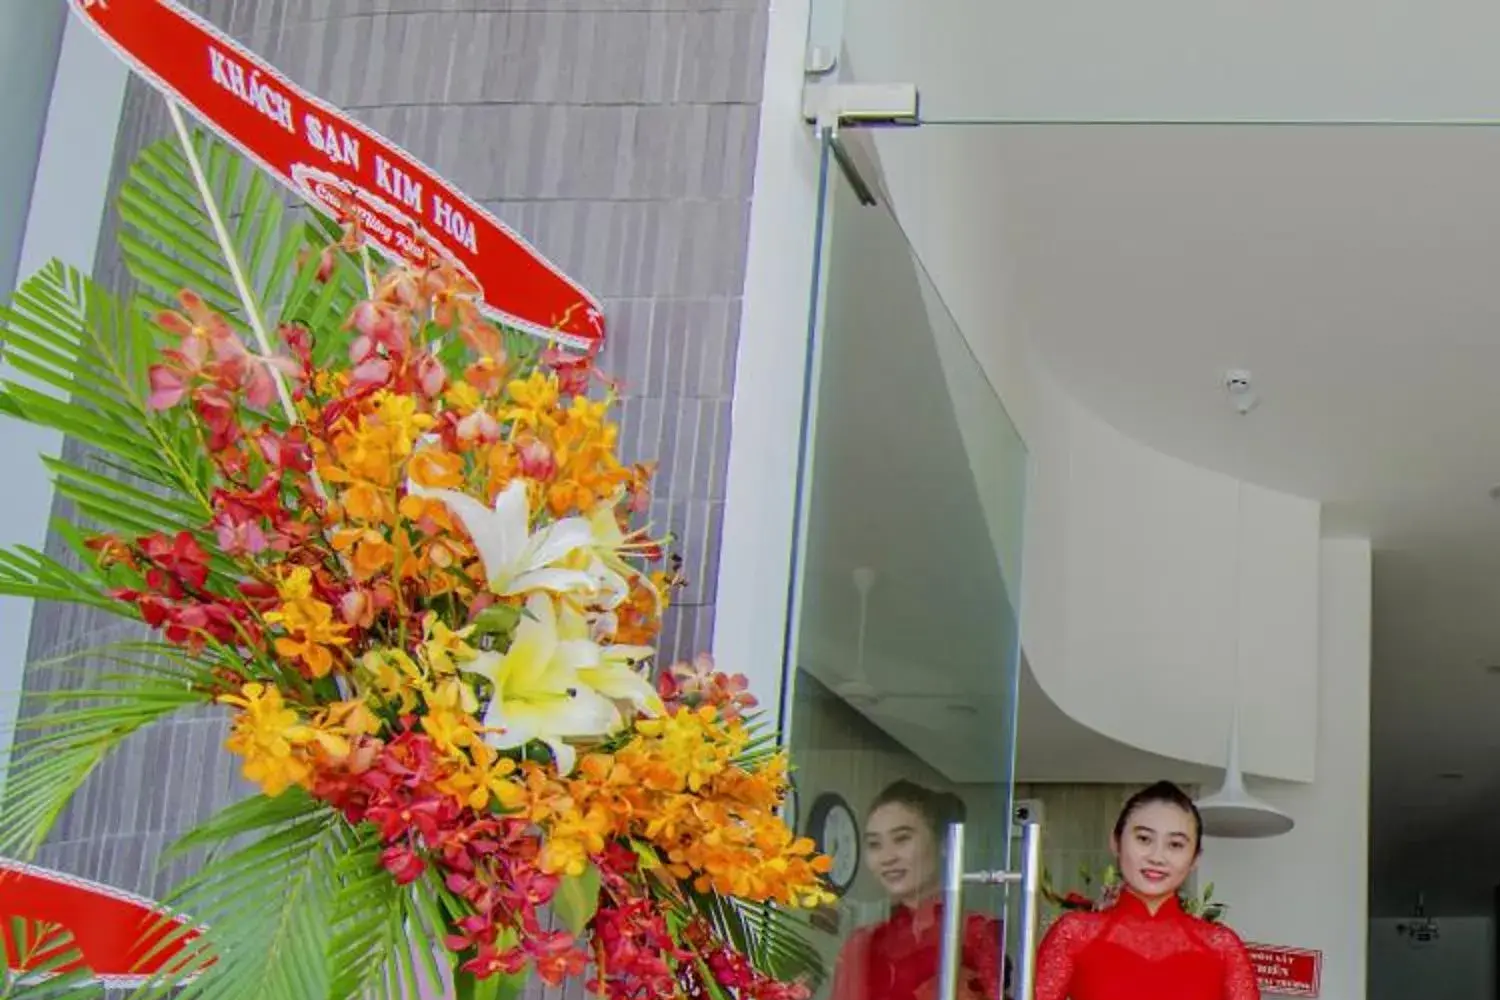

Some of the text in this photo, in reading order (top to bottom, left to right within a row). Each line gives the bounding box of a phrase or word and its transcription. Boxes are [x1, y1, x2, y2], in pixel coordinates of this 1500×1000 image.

[208, 46, 479, 254] KHÁCH SẠN KIM HOA
